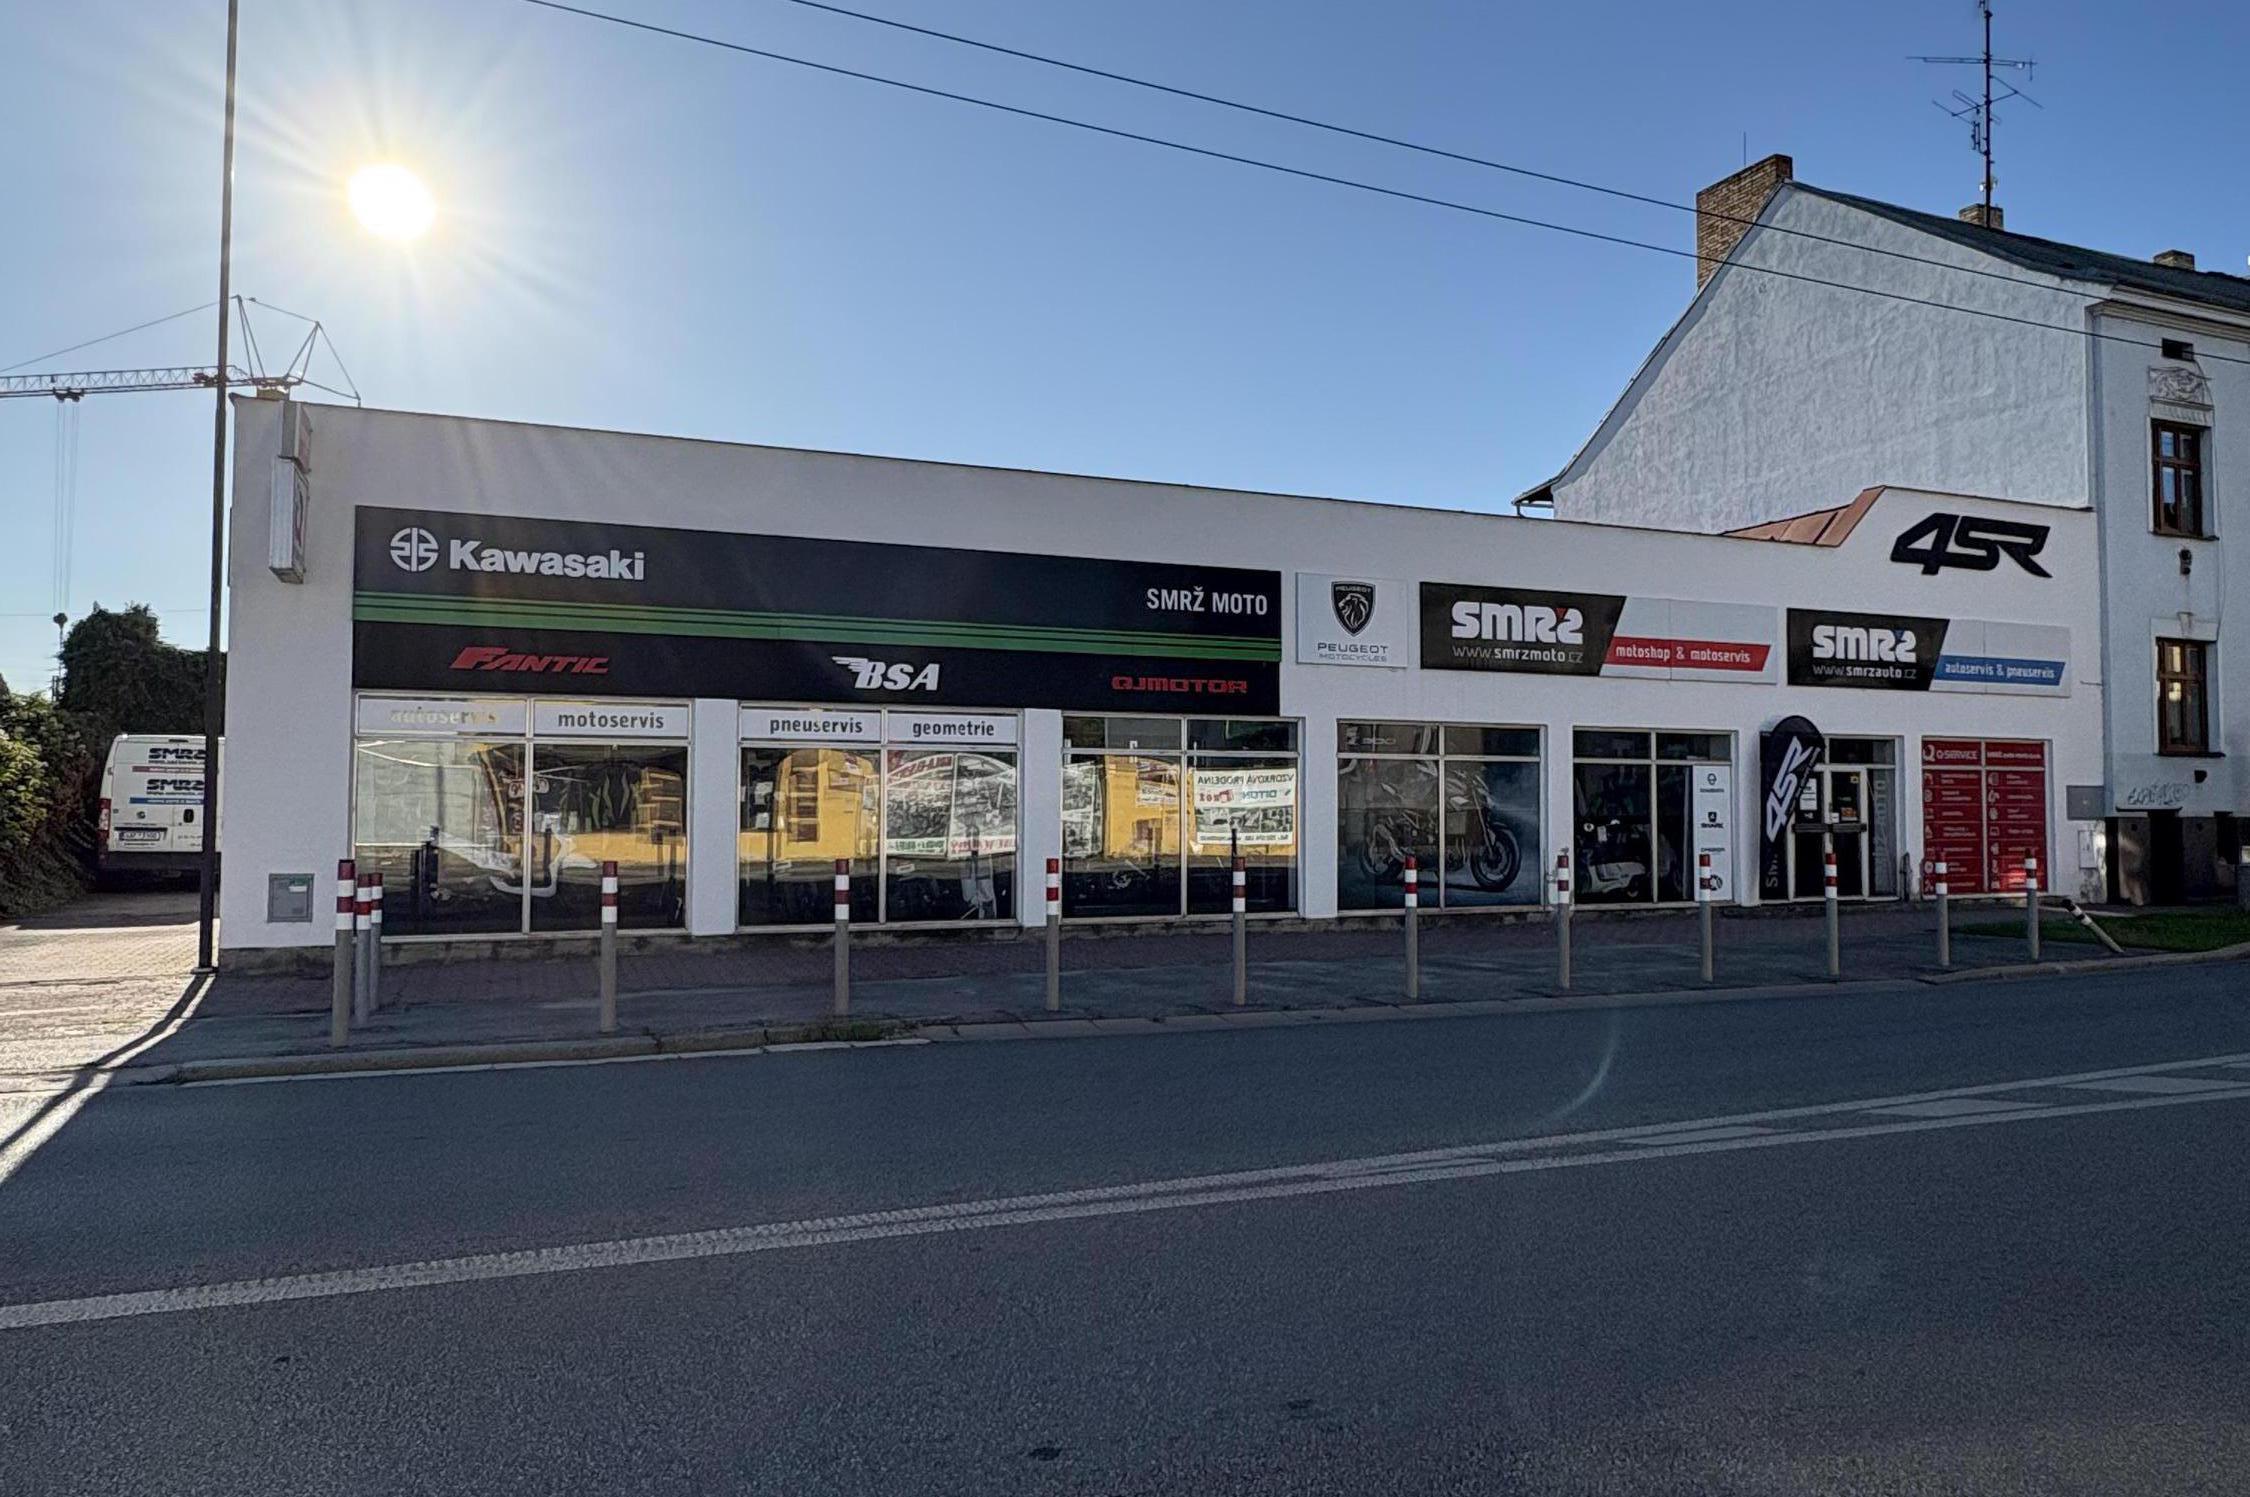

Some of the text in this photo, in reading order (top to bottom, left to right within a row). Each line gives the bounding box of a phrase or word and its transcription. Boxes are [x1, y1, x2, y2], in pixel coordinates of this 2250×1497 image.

[450, 539, 645, 580] Kawasaki
[1335, 585, 1372, 593] PEUGEOT
[1146, 585, 1268, 616] SMRŽ MOTO
[1317, 642, 1389, 654] PEUGEOT
[1318, 653, 1388, 662] MOTOCYCLES
[1615, 644, 1751, 664] motoshop & motoservis
[451, 647, 609, 675] FANTIC
[832, 656, 941, 692] BSA
[558, 710, 664, 729] motoservis
[770, 717, 863, 734] pneuservis
[912, 720, 995, 737] geometrie
